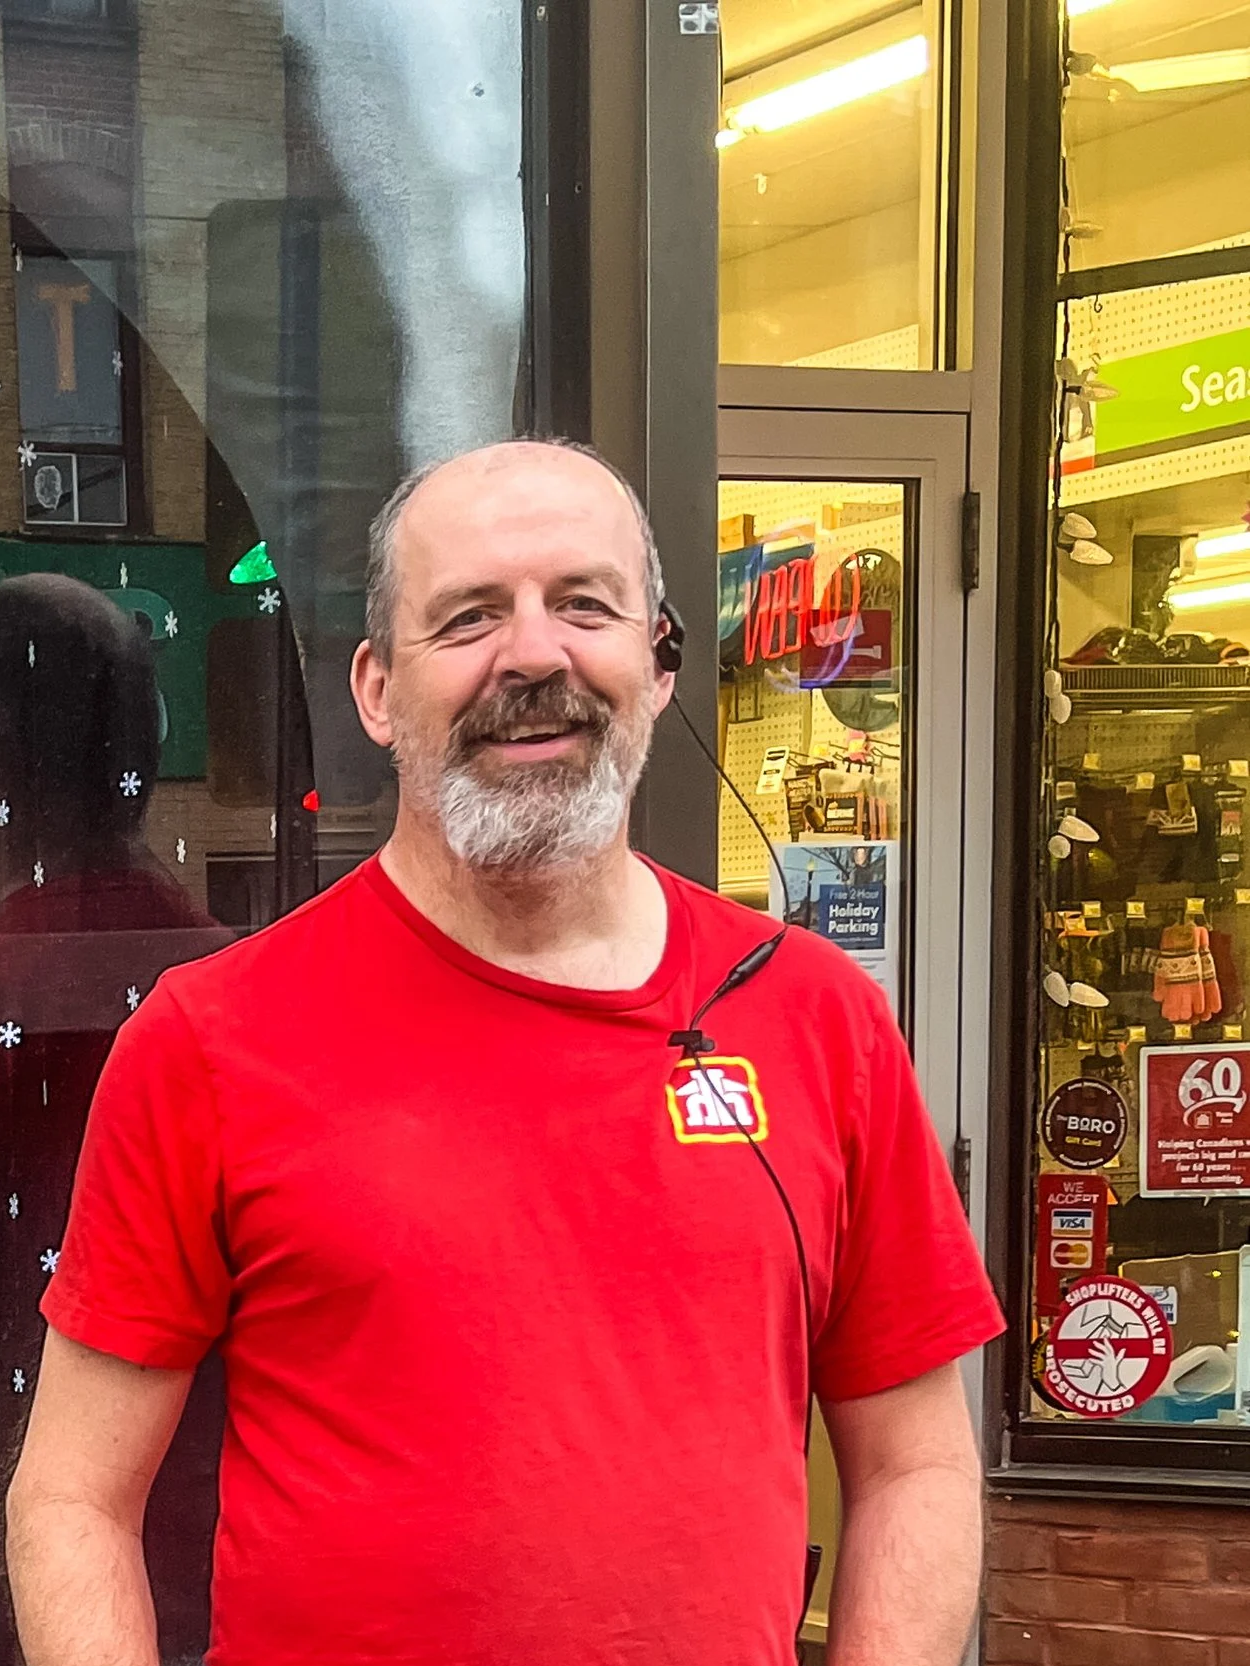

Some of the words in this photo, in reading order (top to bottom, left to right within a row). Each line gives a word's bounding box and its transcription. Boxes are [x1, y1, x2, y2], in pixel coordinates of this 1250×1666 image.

[1180, 364, 1250, 412] Sea
[829, 902, 879, 919] Holiday
[828, 918, 879, 936] Parking
[1178, 1057, 1242, 1109] 60
[1067, 1116, 1116, 1134] BORO
[1196, 1137, 1244, 1148] Canadians
[1175, 1162, 1190, 1172] for
[1205, 1164, 1231, 1174] years
[1062, 1181, 1085, 1193] WE
[1047, 1193, 1100, 1205] ACCEPT
[1059, 1217, 1086, 1229] VISA
[1065, 1282, 1146, 1308] SHOPLIFTERS
[1141, 1305, 1164, 1337] WILL
[1152, 1337, 1167, 1355] BE
[1045, 1344, 1136, 1413] PROSECUTED
